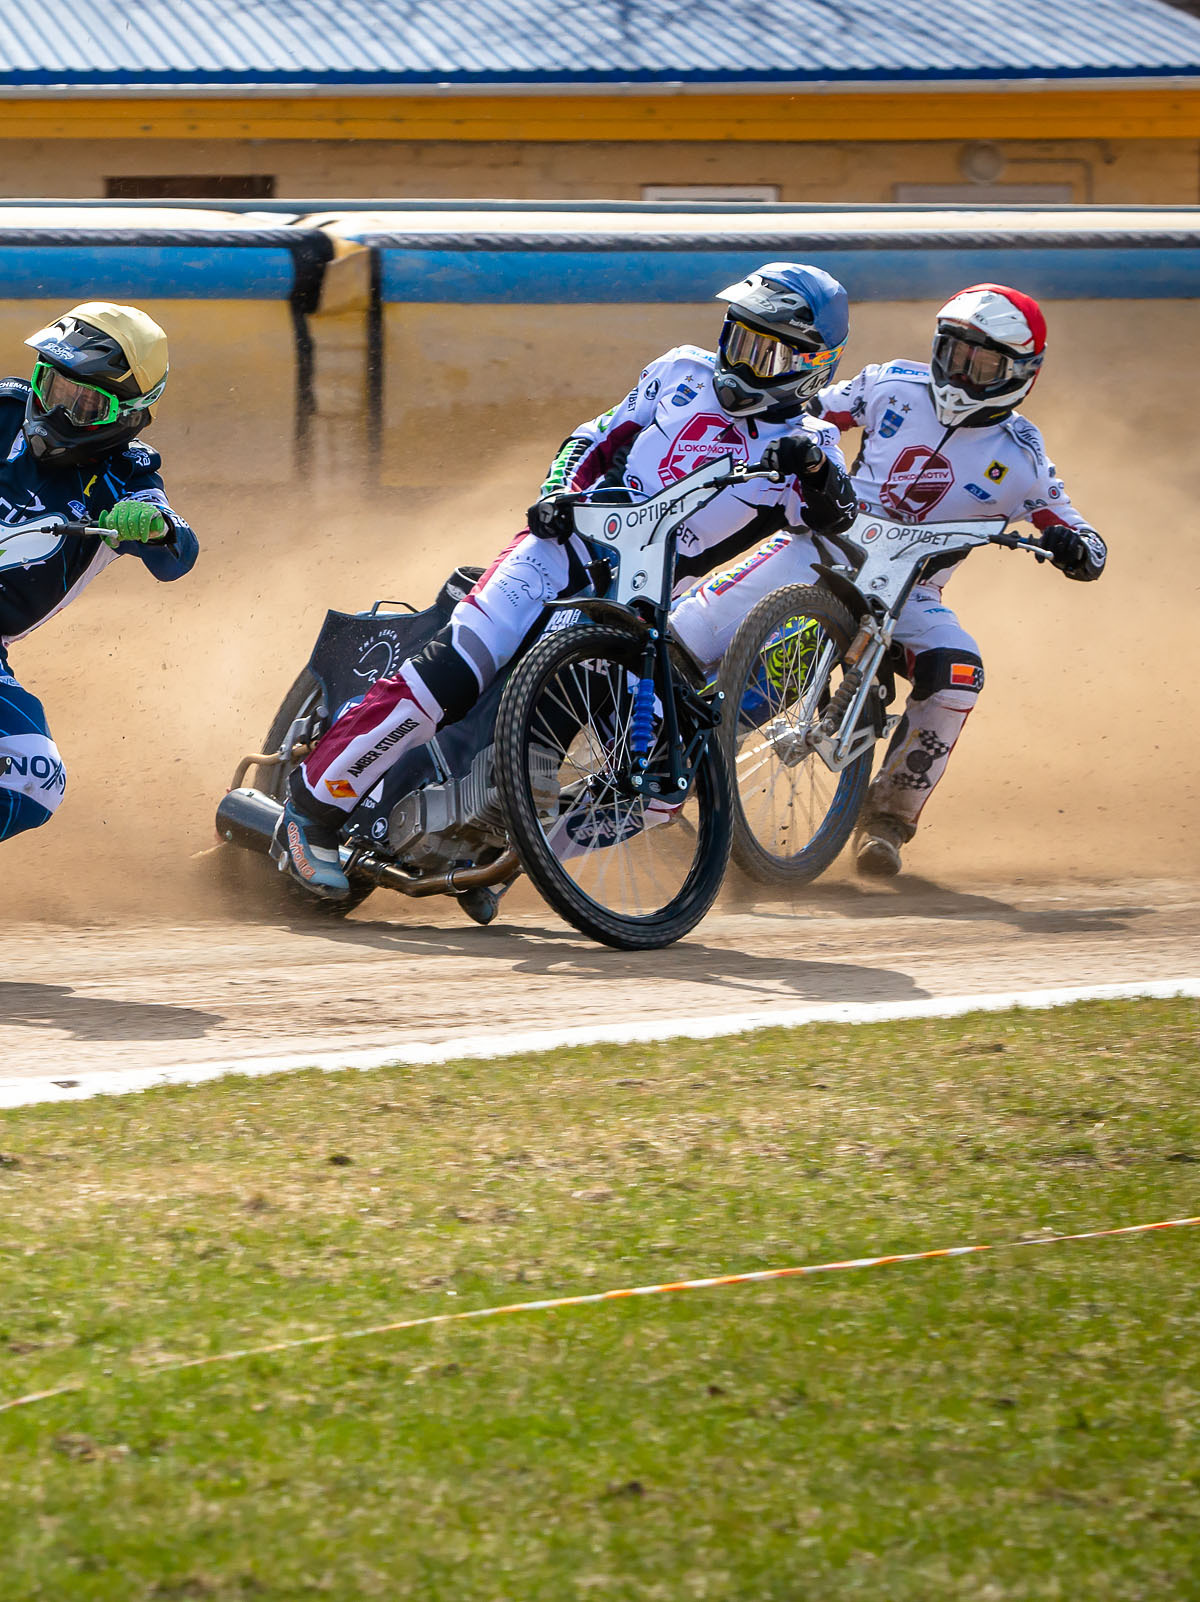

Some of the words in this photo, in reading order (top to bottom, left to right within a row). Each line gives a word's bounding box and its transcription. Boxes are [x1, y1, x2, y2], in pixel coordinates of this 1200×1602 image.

[678, 443, 744, 456] LOKOMOTIV
[892, 471, 950, 482] LOKOMOTIV
[626, 498, 687, 528] OPTIBET
[886, 526, 953, 546] OPTIBET
[347, 750, 383, 778] AMBER
[374, 717, 421, 752] STUDIOS
[287, 821, 317, 881] daytona
